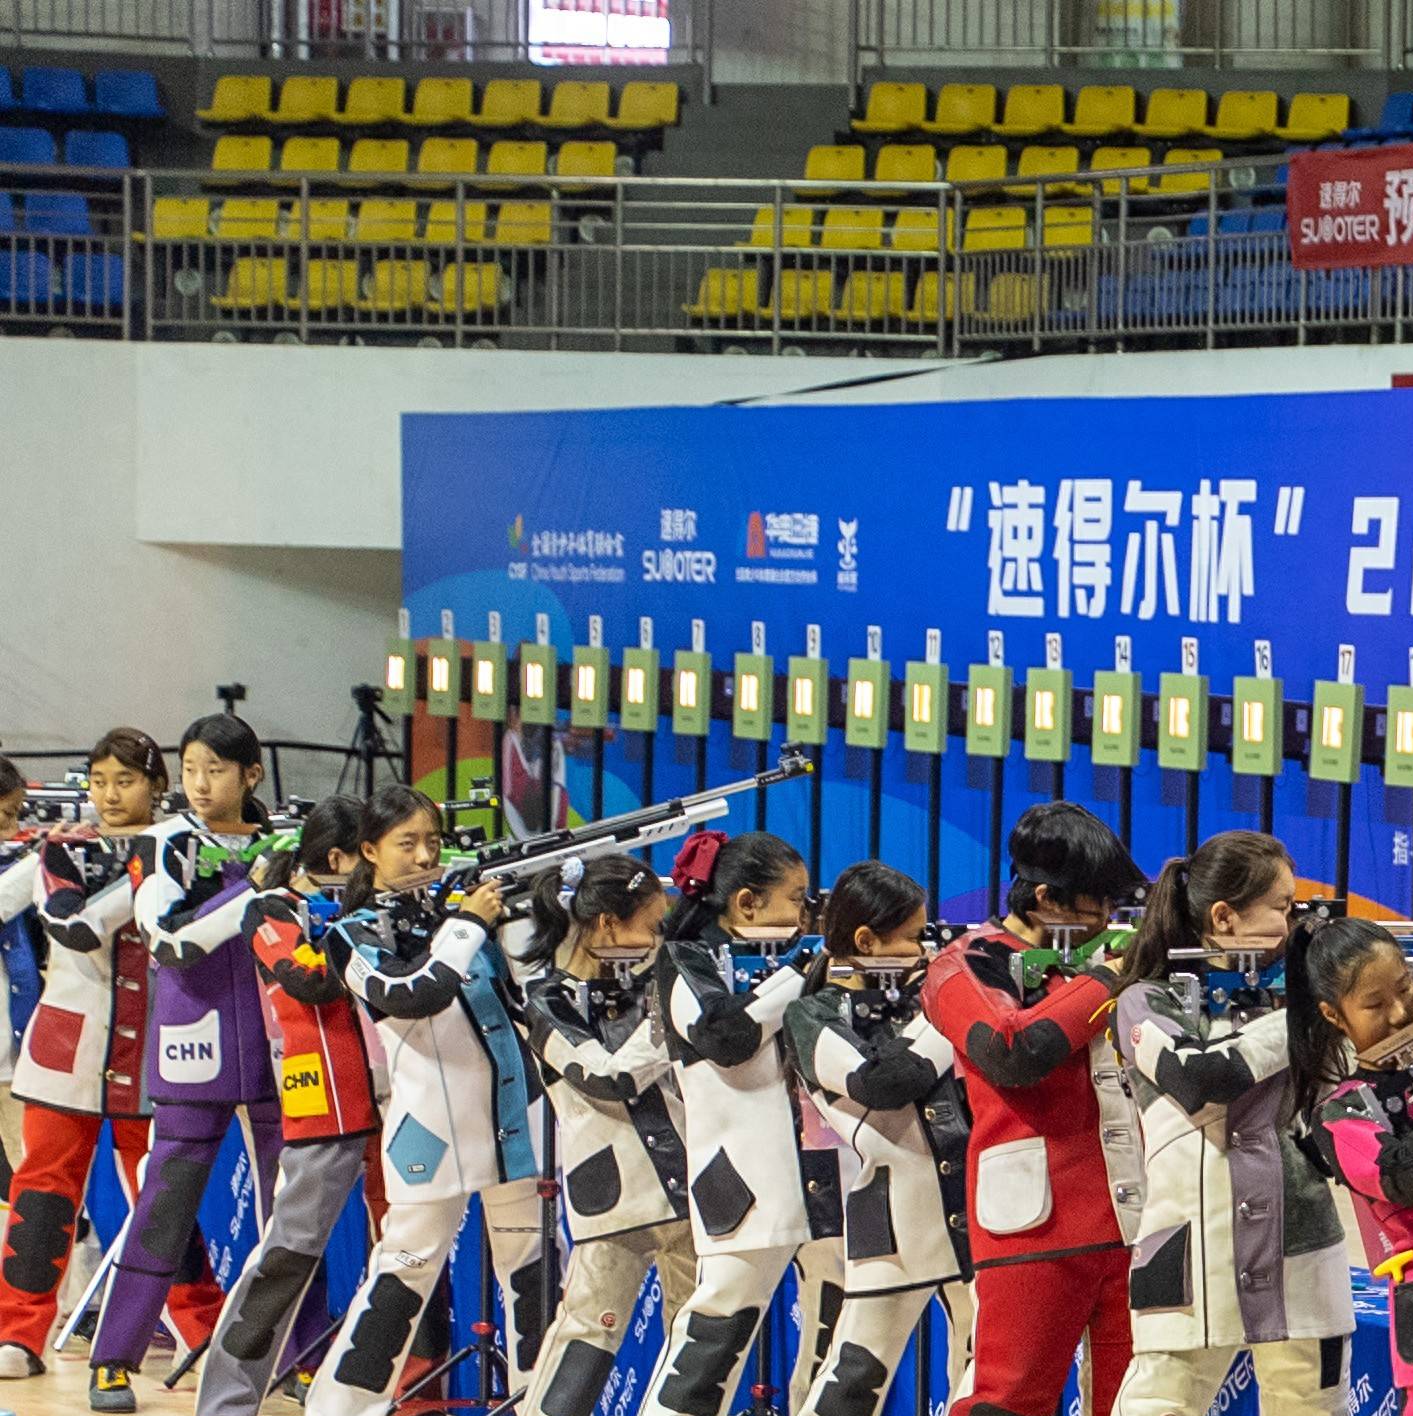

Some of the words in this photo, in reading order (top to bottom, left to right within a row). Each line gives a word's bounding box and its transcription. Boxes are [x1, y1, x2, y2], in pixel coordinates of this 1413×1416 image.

[1319, 180, 1361, 209] 速得尔
[929, 635, 938, 656] 11
[990, 637, 1000, 659] 12
[1048, 639, 1058, 662] 13
[1117, 643, 1129, 662] 14
[1185, 643, 1194, 667] 15
[1257, 646, 1268, 670] 16
[1341, 650, 1352, 674] 17
[166, 1042, 214, 1061] CHN
[283, 1070, 320, 1091] CHN
